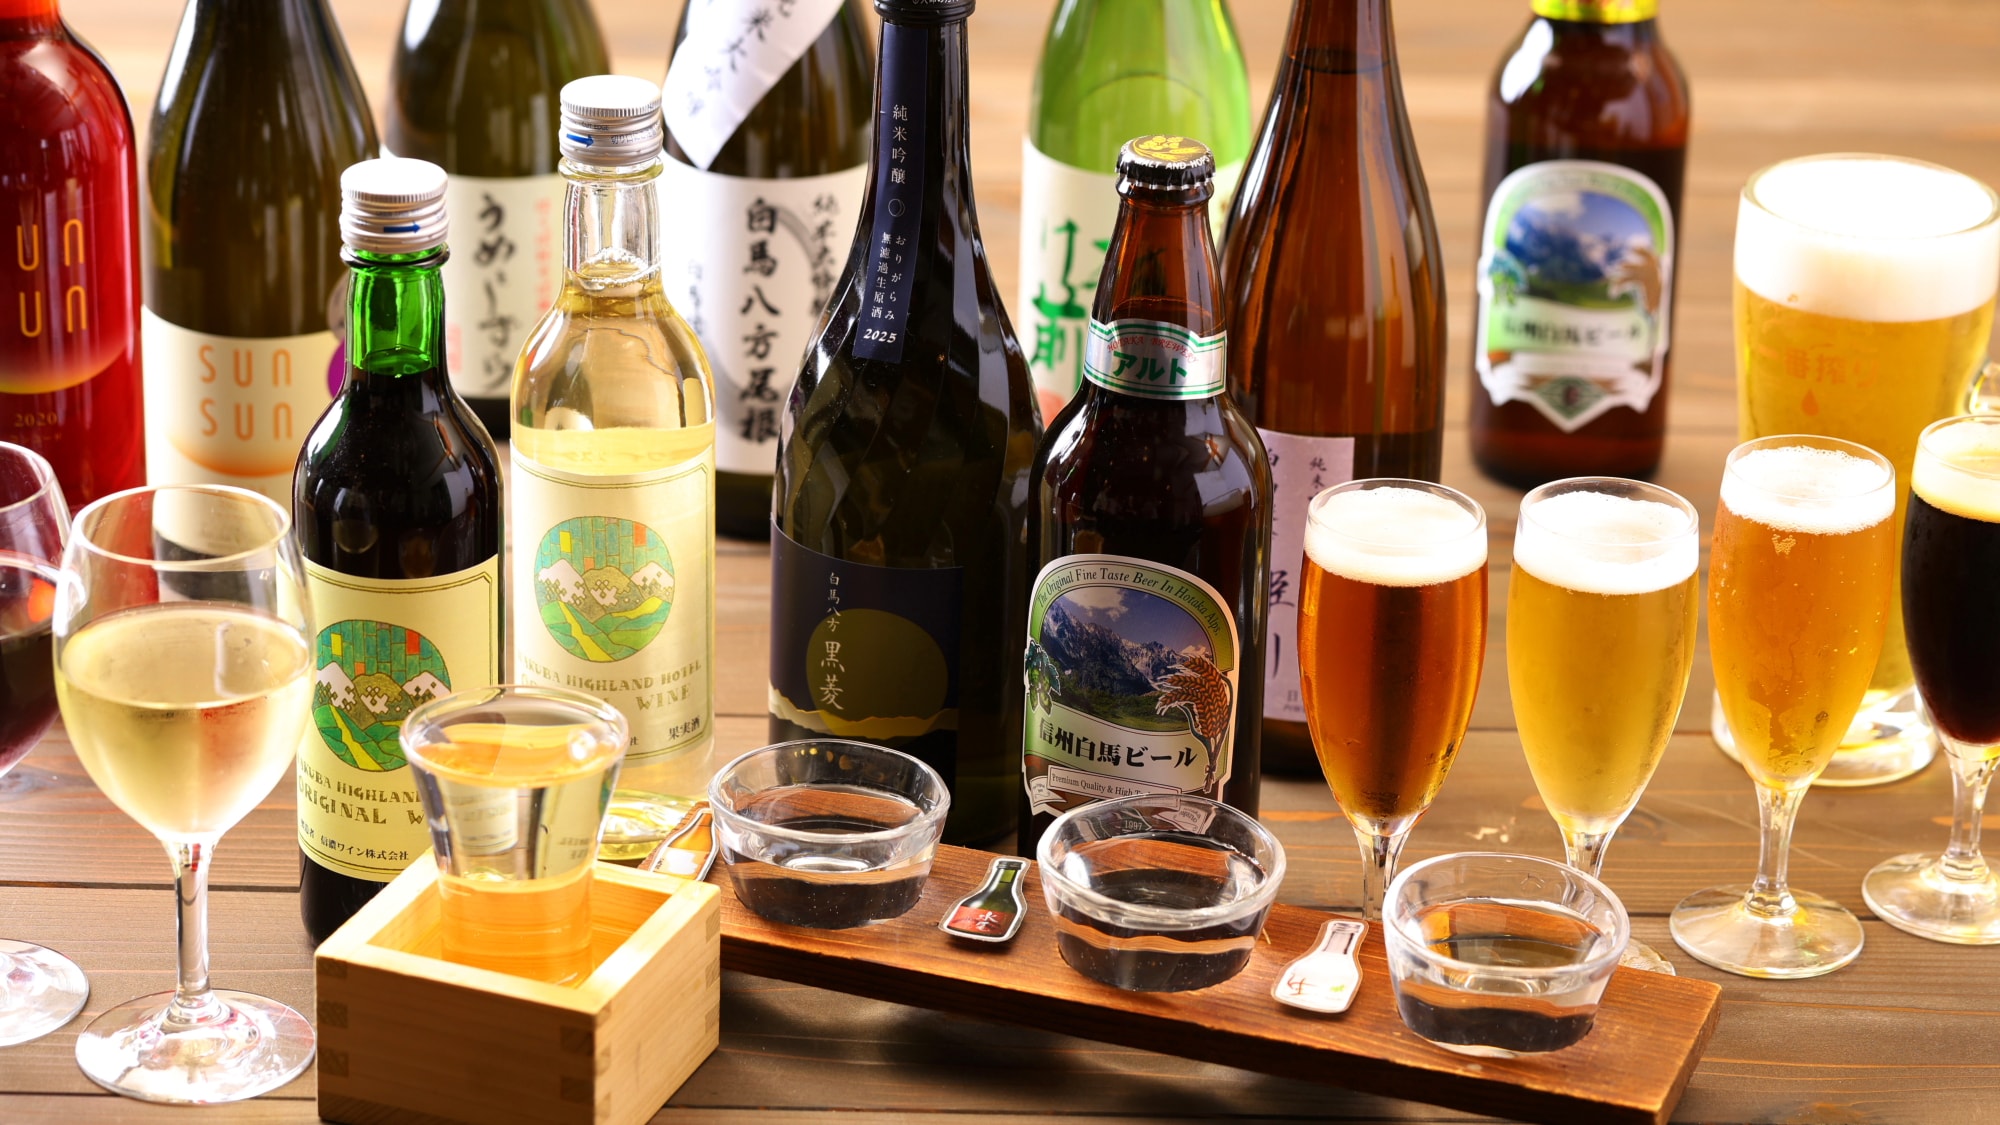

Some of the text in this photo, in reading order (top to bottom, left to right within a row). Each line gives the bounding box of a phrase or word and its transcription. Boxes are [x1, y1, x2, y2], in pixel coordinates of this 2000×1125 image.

[891, 104, 908, 185] 純米吟醸
[885, 235, 906, 320] おりがらみ
[740, 197, 780, 444] 白馬八方尾根
[863, 328, 897, 343] 2025
[199, 344, 292, 388] SUN
[1107, 336, 1145, 352] HOTAKA
[1113, 350, 1188, 385] アルト
[14, 411, 58, 428] 2020
[200, 397, 294, 441] SUN
[826, 572, 842, 632] 白馬八方
[1046, 571, 1074, 596] Original
[1075, 568, 1098, 582] Fine
[1099, 567, 1130, 582] Taste
[1132, 571, 1159, 587] Beer
[1160, 580, 1174, 594] In
[1174, 586, 1208, 615] Hotaka
[566, 674, 655, 692] HIGHLAND
[661, 659, 702, 686] HOTEL
[635, 683, 691, 711] WINE
[819, 640, 846, 710] 黒菱
[668, 716, 701, 741] 果実酒
[1039, 716, 1199, 769] 信州白馬ビール
[298, 756, 332, 789] AKUBA
[1052, 772, 1080, 787] Premium
[1080, 779, 1107, 793] Quality
[1107, 786, 1114, 794] &
[1115, 787, 1134, 799] High
[298, 775, 387, 825] ORIGINAL
